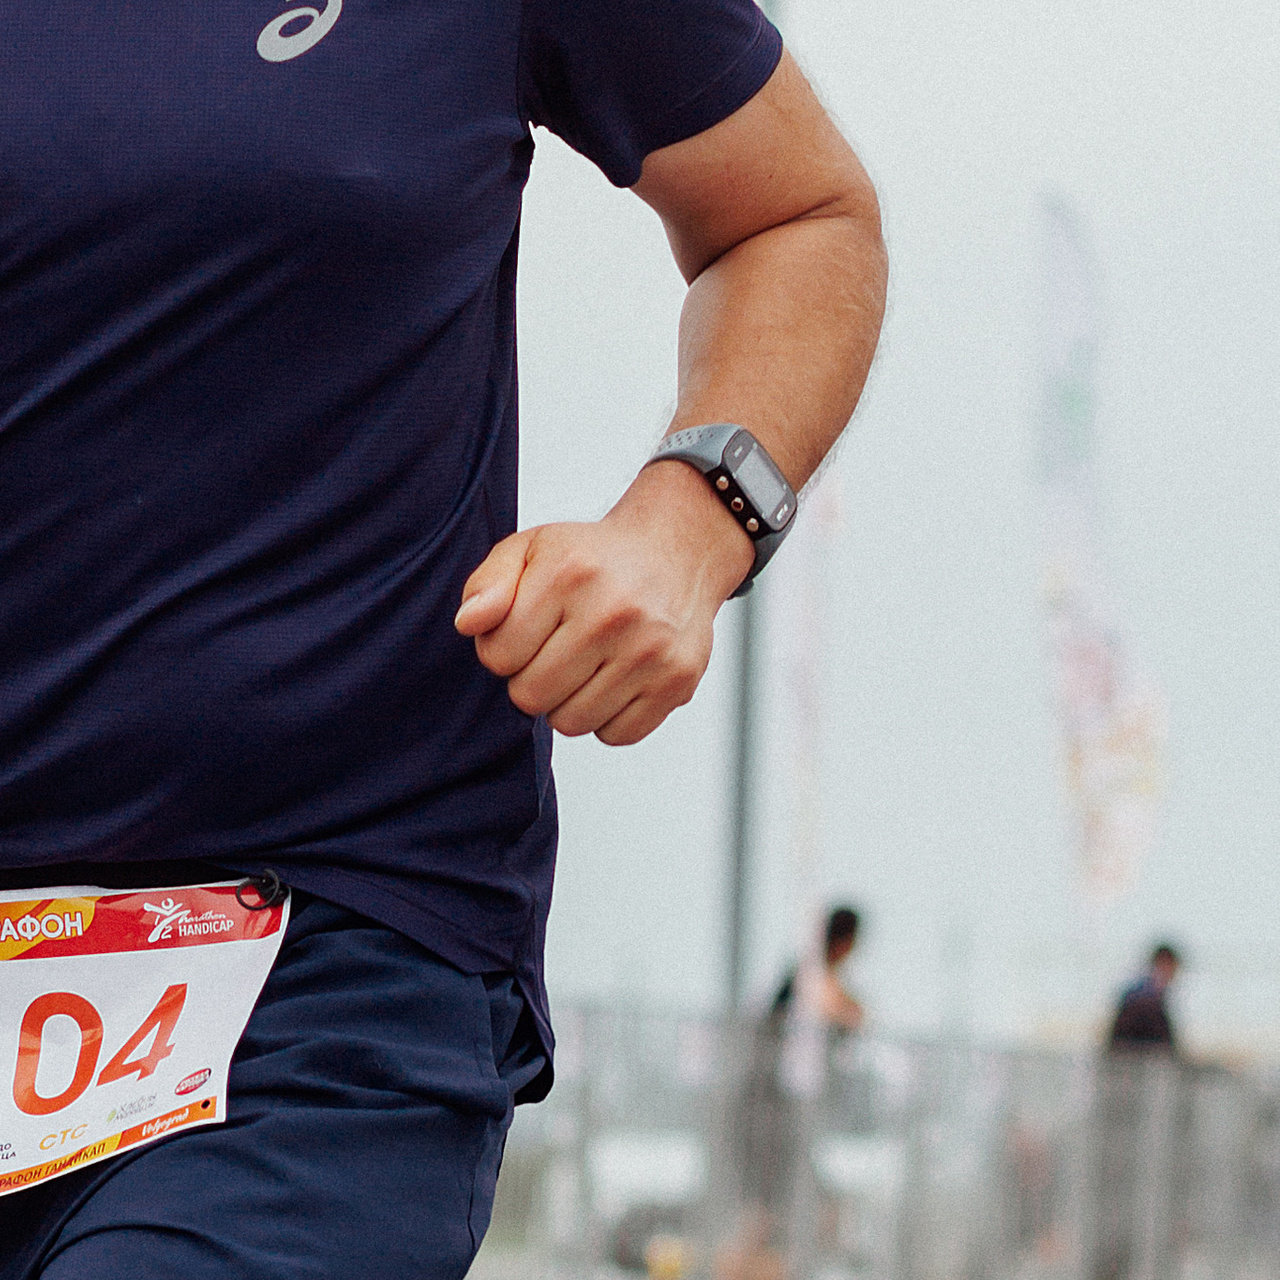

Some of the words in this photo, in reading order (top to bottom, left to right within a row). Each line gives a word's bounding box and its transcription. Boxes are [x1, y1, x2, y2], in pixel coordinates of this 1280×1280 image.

[179, 919, 235, 937] HANDICAP
[39, 1123, 88, 1150] СТС
[45, 1142, 107, 1175] ГАНДИКАП
